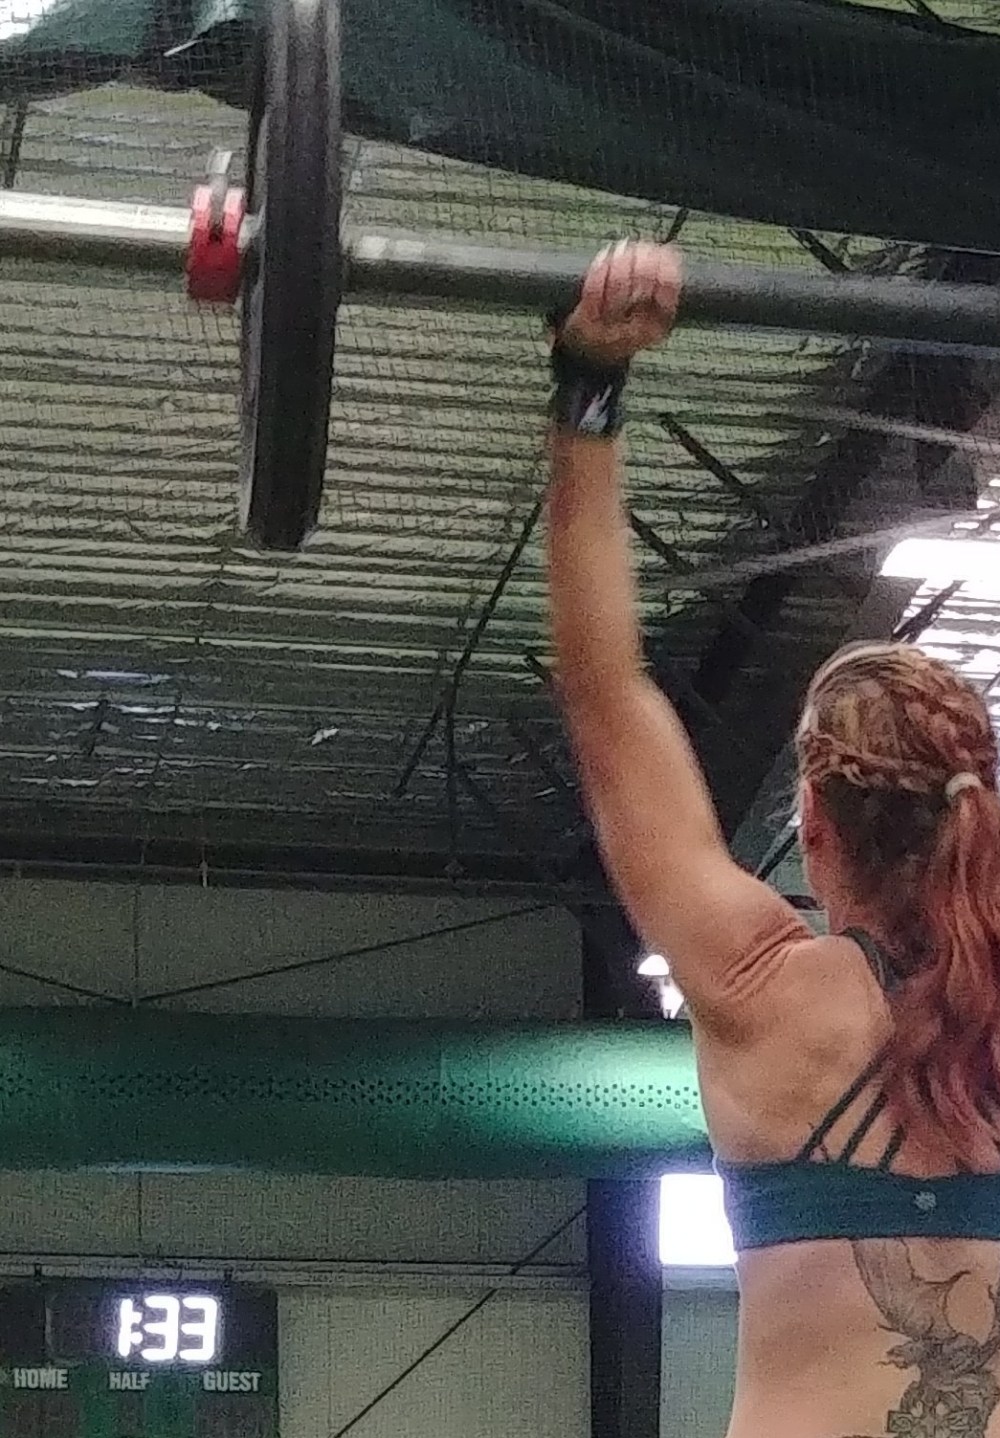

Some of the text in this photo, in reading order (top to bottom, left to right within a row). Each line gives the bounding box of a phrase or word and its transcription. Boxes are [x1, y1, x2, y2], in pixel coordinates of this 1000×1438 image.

[117, 1295, 218, 1361] 1:33
[14, 1368, 69, 1390] HOME
[109, 1371, 151, 1391] HALF
[203, 1371, 262, 1392] GUEST
